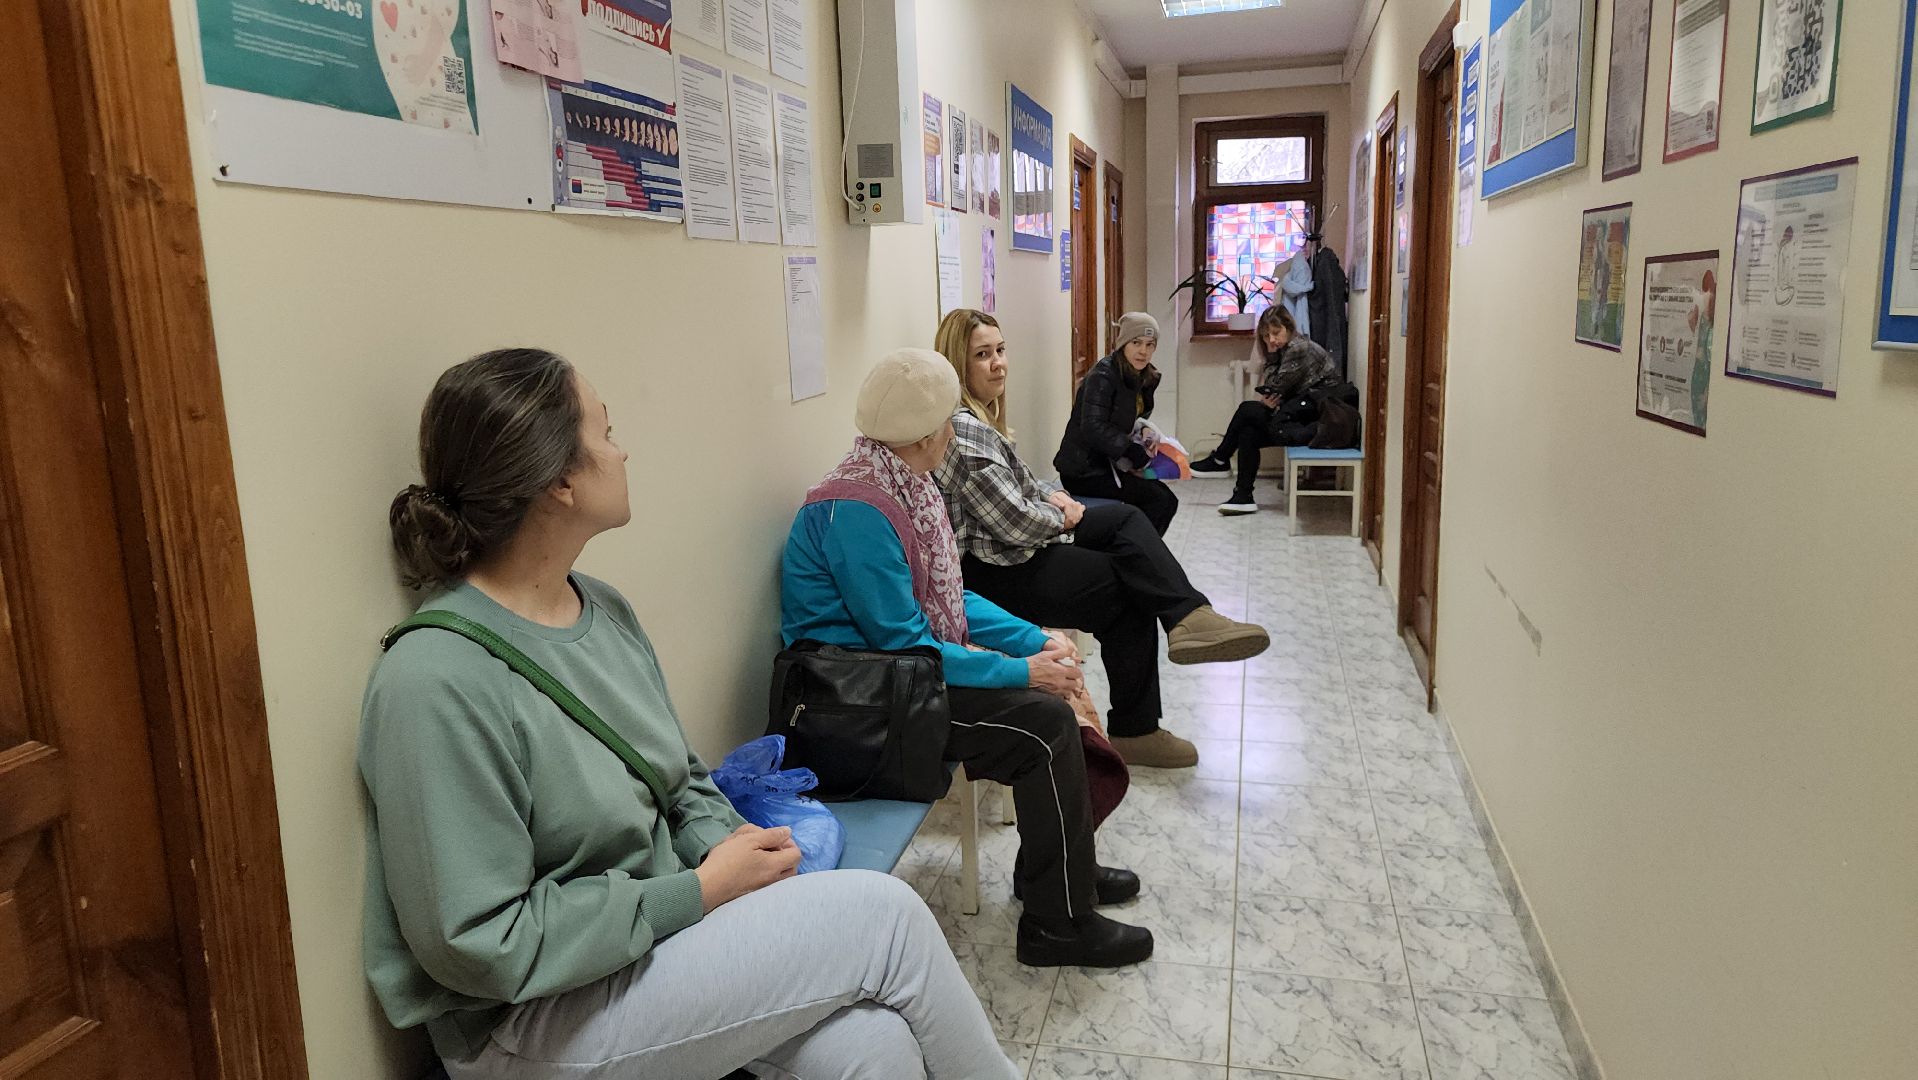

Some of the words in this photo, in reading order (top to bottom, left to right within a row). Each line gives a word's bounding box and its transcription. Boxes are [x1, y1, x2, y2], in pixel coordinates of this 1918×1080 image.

[298, 0, 363, 19] -30-03
[588, 1, 655, 43] ПОДПИШИСЬ
[1013, 104, 1052, 152] ИНФОРМАЦИЯ
